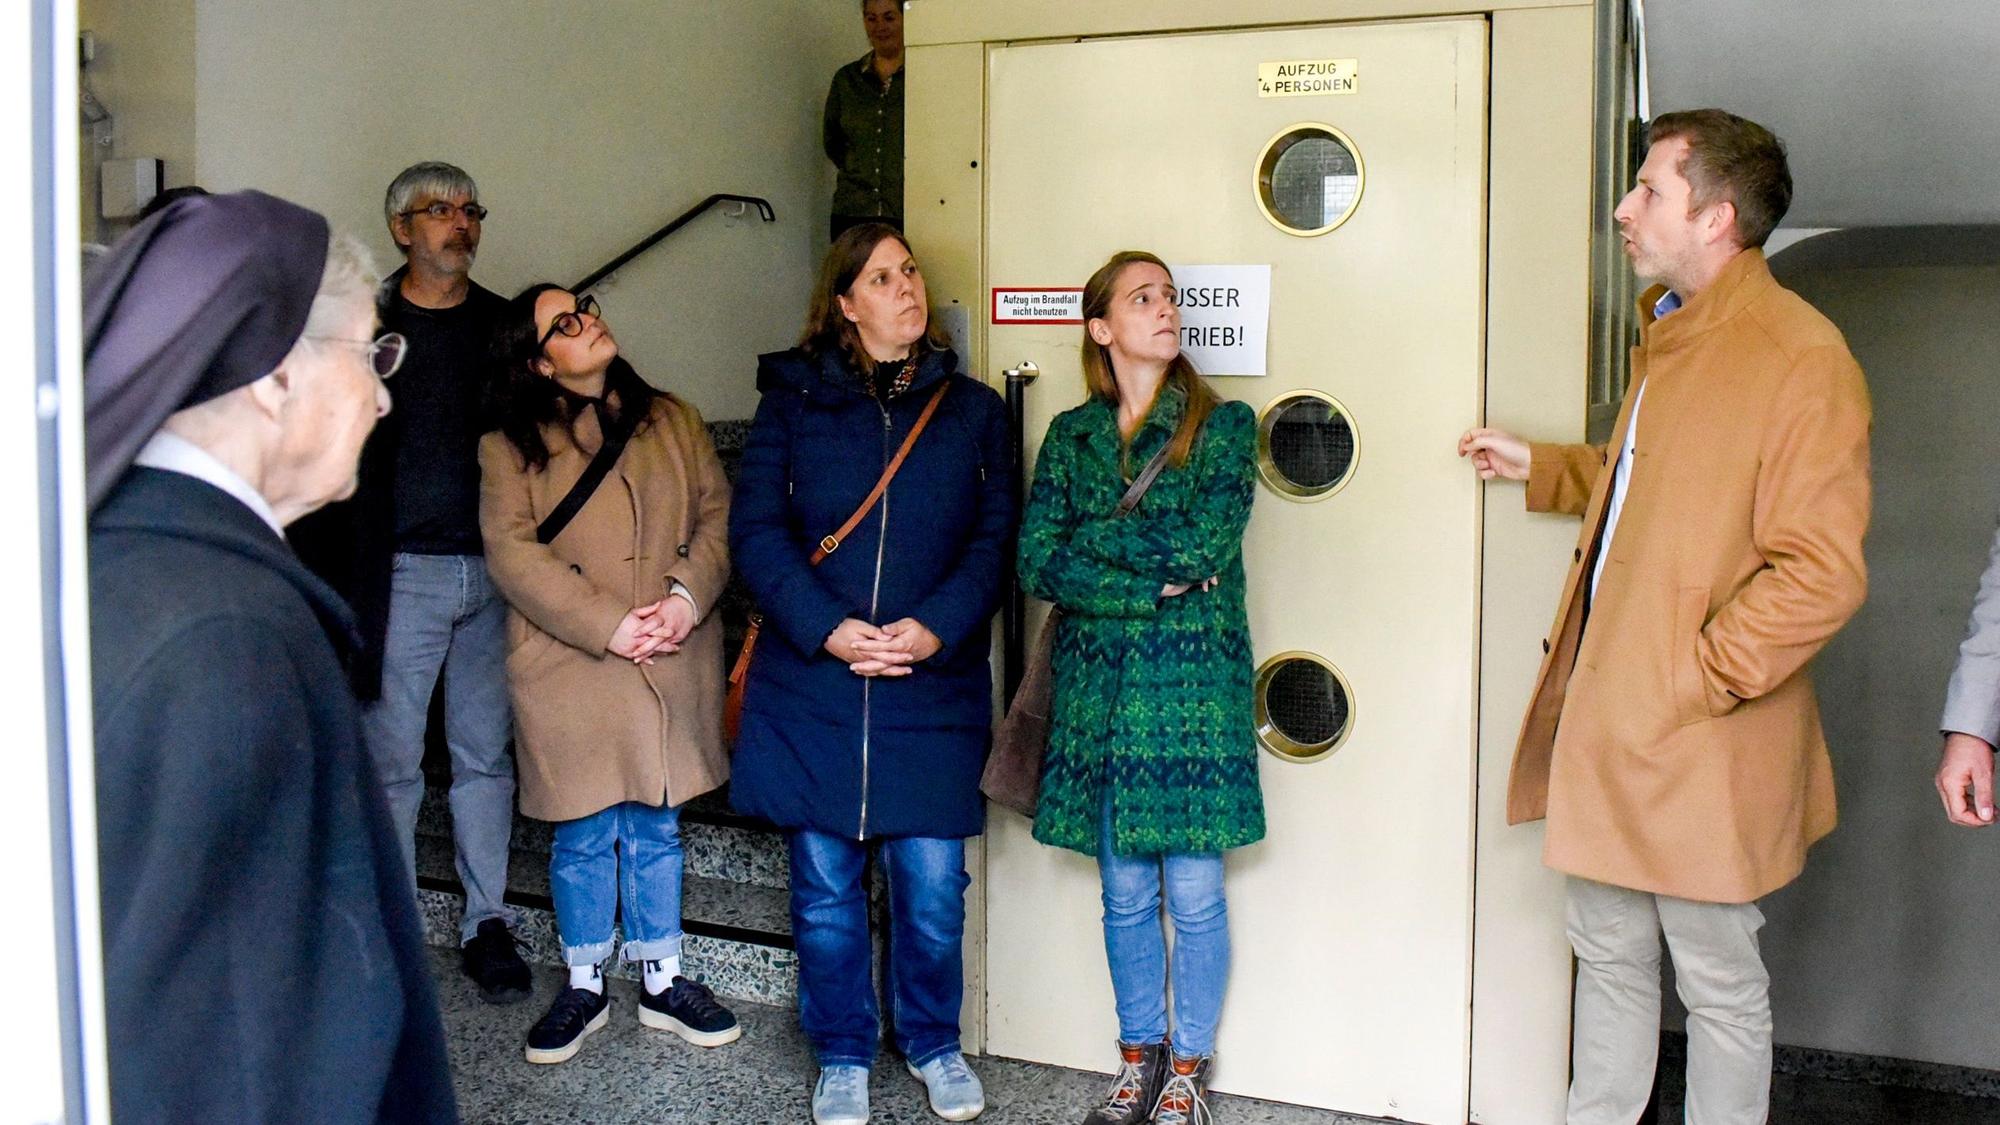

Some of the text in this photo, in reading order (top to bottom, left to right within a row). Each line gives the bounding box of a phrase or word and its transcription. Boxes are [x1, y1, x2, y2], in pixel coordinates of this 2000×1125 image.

[1277, 63, 1337, 77] AUFZUG
[1262, 78, 1352, 93] 4 PERSONEN
[1003, 294, 1077, 306] Aufzug im Brandfall
[1012, 306, 1068, 316] nicht benutzen
